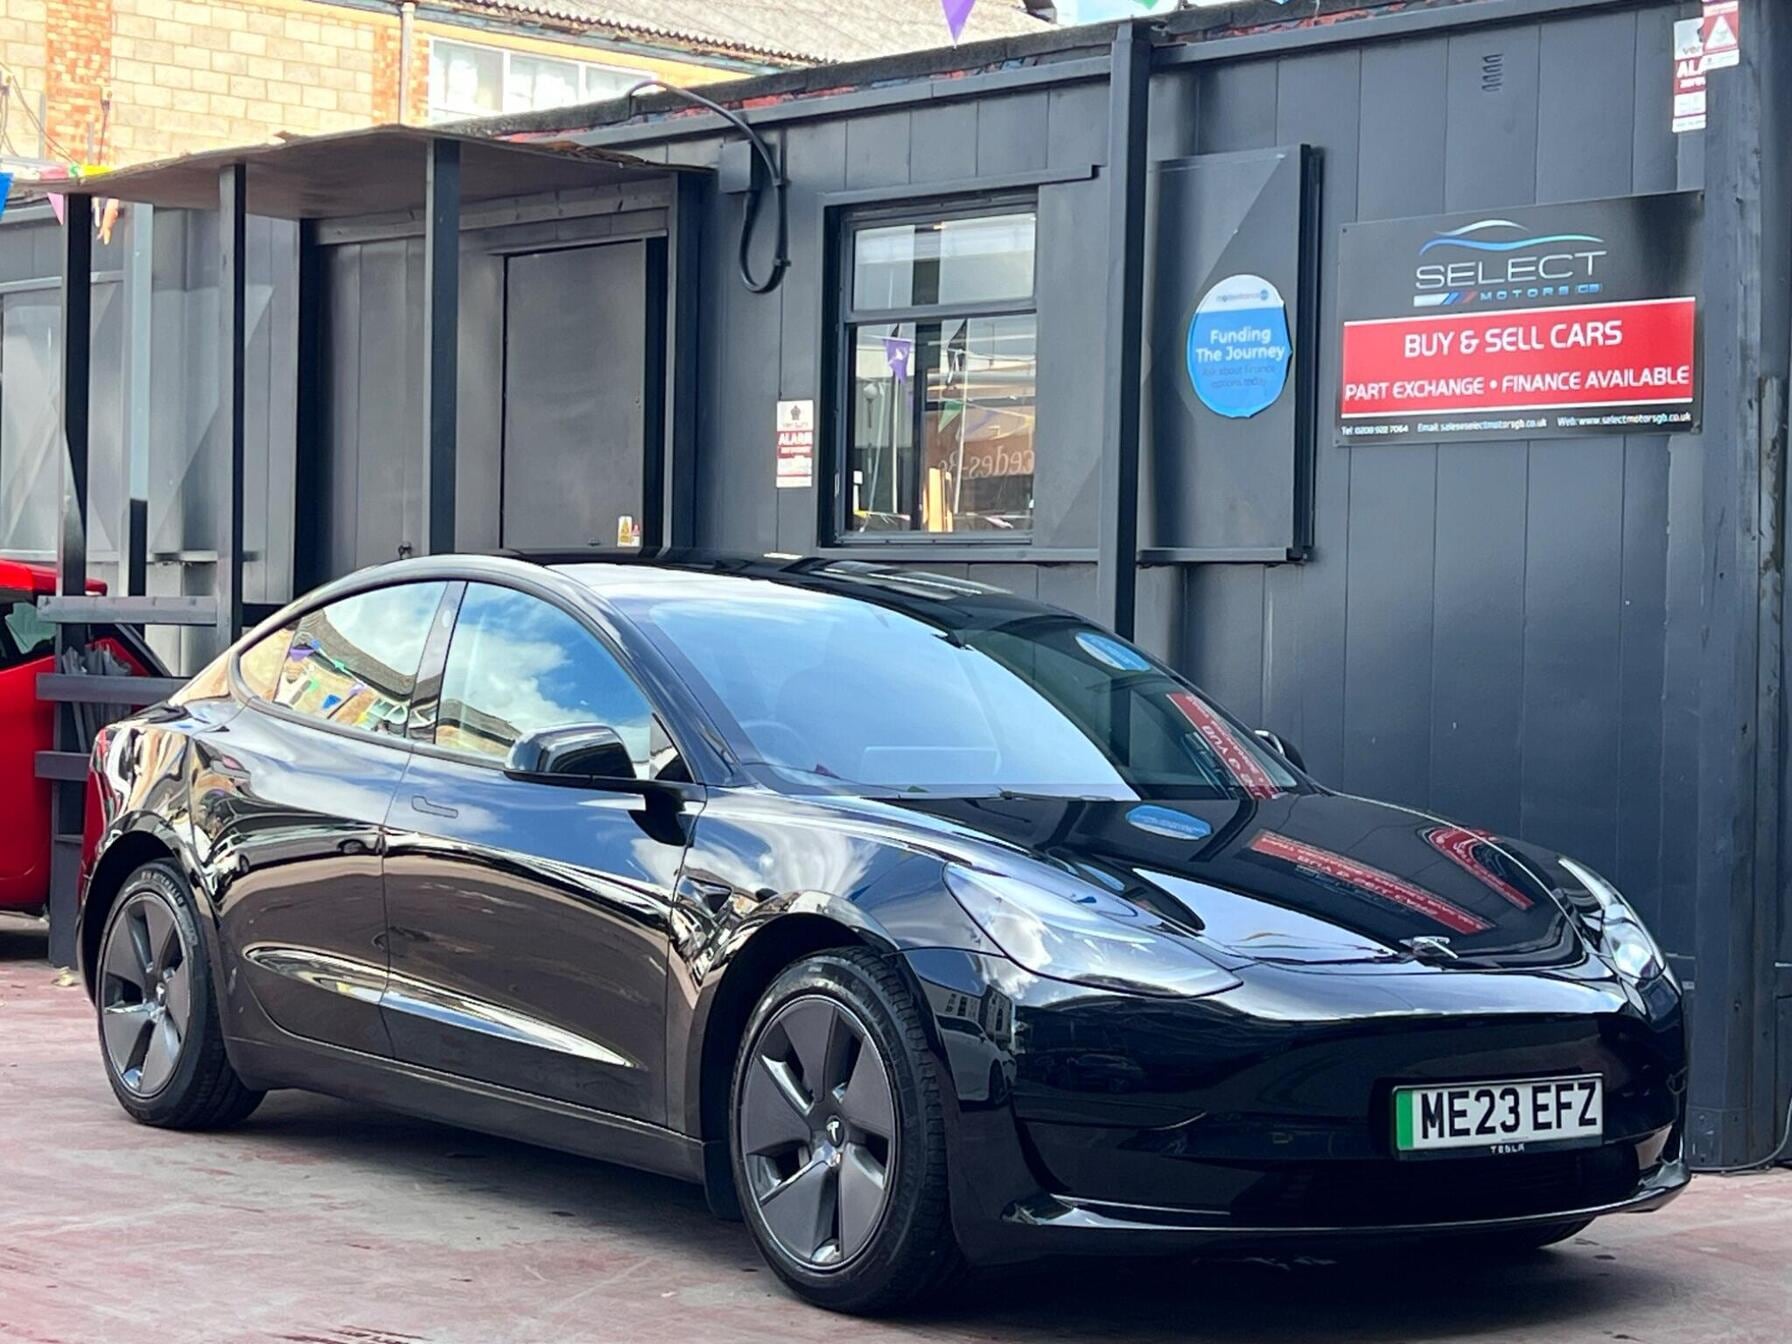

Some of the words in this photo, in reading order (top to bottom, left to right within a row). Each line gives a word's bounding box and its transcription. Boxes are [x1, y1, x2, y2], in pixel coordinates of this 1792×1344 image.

[1416, 251, 1607, 289] SELECT
[1480, 286, 1569, 301] MOTORS
[1210, 326, 1272, 345] Funding
[1404, 331, 1455, 358] BUY
[1460, 330, 1480, 354] &
[1485, 326, 1544, 353] SELL
[1550, 320, 1623, 348] CARS
[1196, 348, 1222, 363] The
[1226, 345, 1285, 362] Journey
[1345, 382, 1390, 400] PART
[1392, 377, 1485, 399] EXCHANGE
[1502, 371, 1581, 393] FINANCE
[1585, 365, 1690, 389] AVAILABLE
[1420, 1087, 1521, 1140] ME23
[1532, 1081, 1598, 1132] EFZ
